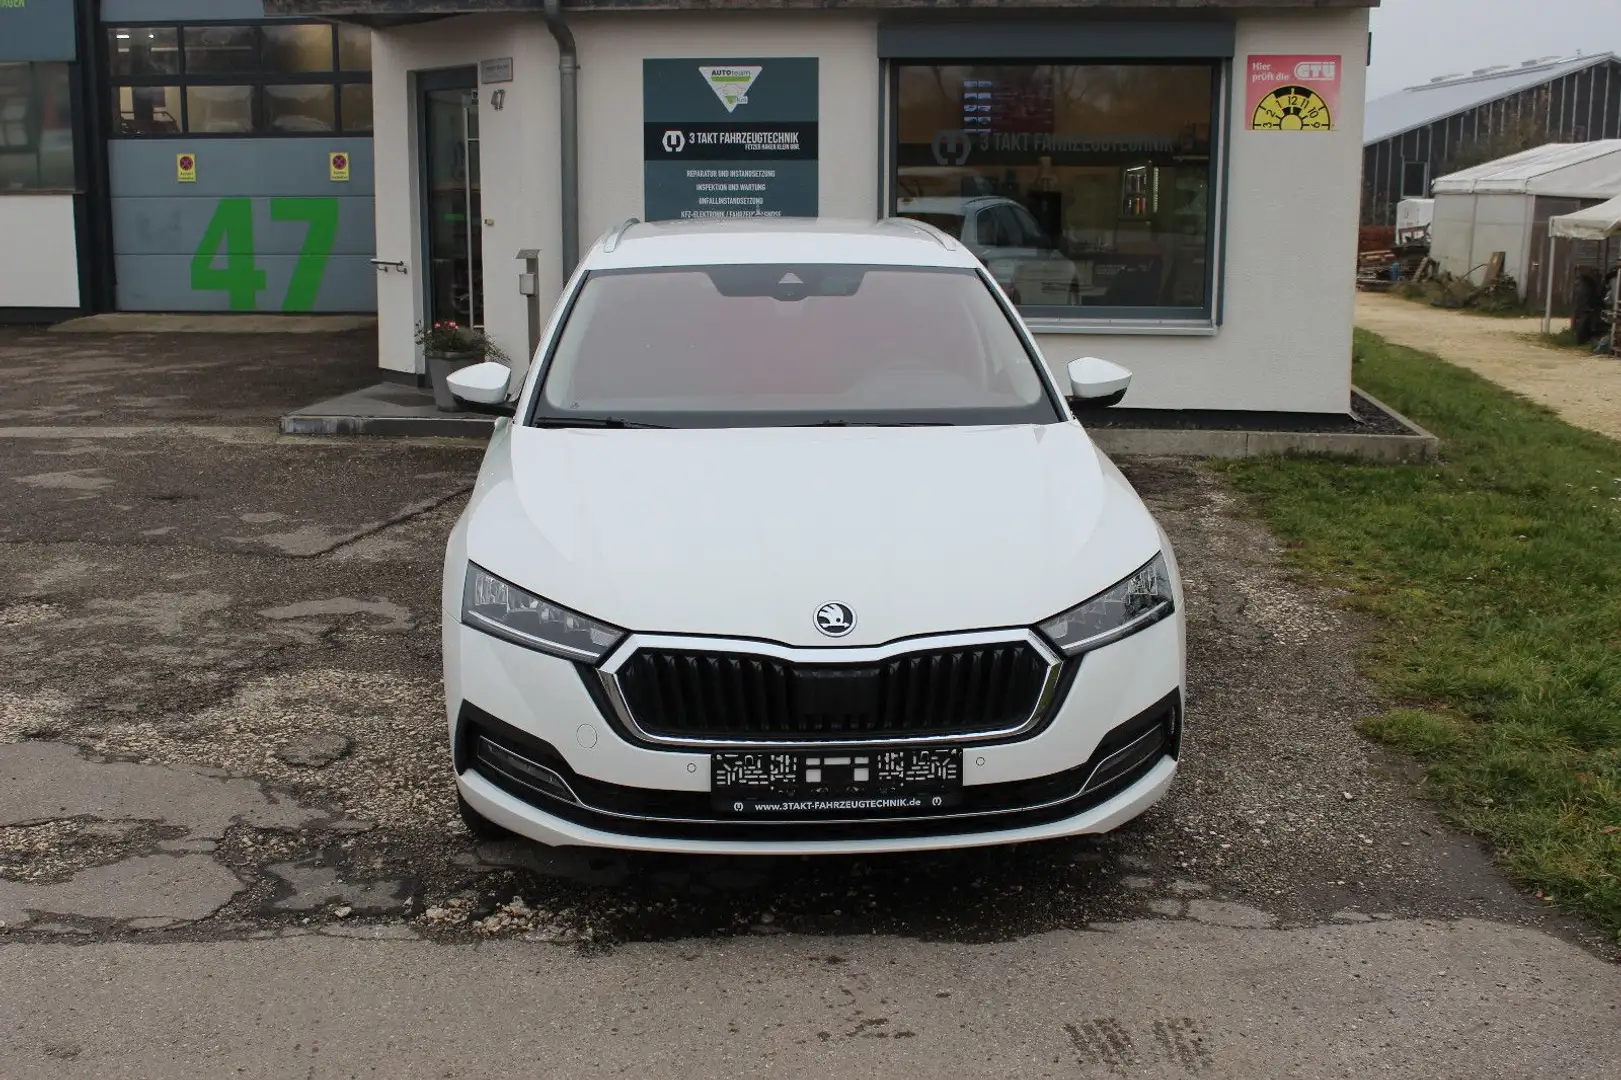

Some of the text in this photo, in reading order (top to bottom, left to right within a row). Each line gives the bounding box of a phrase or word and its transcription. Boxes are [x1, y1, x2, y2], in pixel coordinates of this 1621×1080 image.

[1252, 62, 1272, 71] Hier
[1296, 62, 1335, 79] GTÜ
[1252, 72, 1289, 83] prüft die
[1288, 96, 1298, 105] 12
[689, 132, 799, 144] 3 TAKT FAHRZEUGTECHNIK
[993, 132, 1029, 151] TAKT
[696, 183, 766, 191] INSPEKTION UND WARTUNG
[191, 197, 339, 311] 47
[755, 798, 921, 811] www.3TAKT-FAHRZEUGTECHNIK.de
